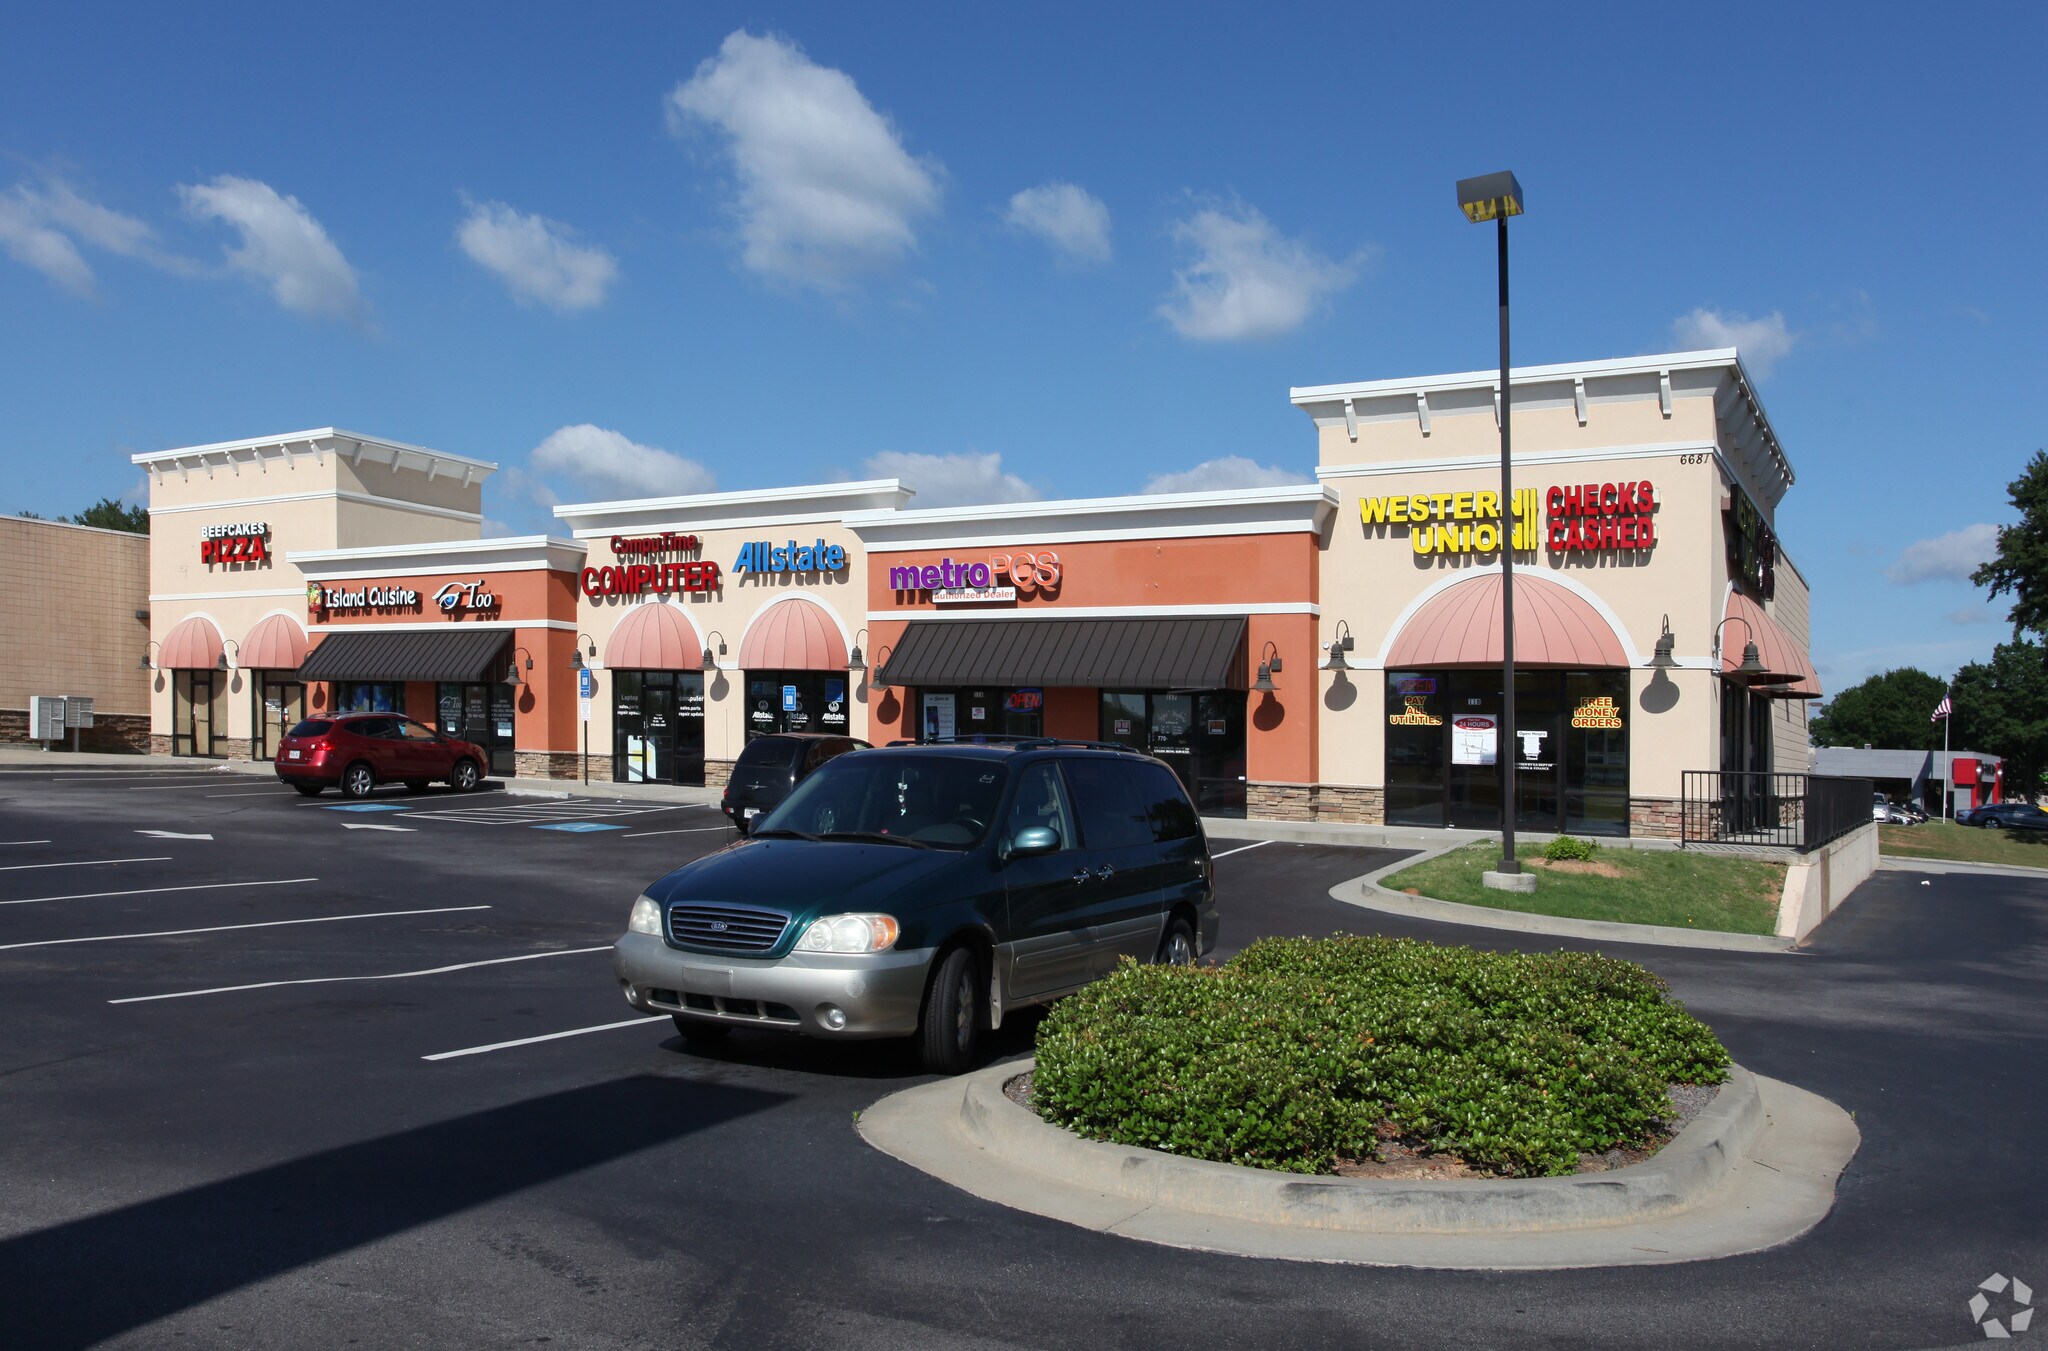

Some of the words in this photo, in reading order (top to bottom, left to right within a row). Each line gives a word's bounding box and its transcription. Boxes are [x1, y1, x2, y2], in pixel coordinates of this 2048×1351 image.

[1680, 454, 1709, 465] 6681
[1546, 480, 1654, 517] CHECKS
[1360, 489, 1523, 524] WESTERN
[201, 522, 265, 538] BEEFCAKES
[1549, 517, 1654, 551] CASHED
[610, 531, 697, 556] CompuTime
[1412, 522, 1523, 554] UNION
[201, 536, 265, 564] PIZZA
[732, 538, 844, 573] Allstate
[889, 551, 1059, 590] metroPCS
[581, 561, 718, 596] COMPUTER
[325, 587, 366, 608] Island
[369, 585, 416, 606] Cuisine
[465, 580, 492, 608] Too
[934, 591, 982, 601] Authorized
[983, 590, 1015, 599] Dealer
[1398, 680, 1434, 692] OPEN
[621, 694, 639, 702] Laptop
[678, 695, 704, 703] computer
[1009, 693, 1040, 708] OPEN
[1405, 696, 1427, 706] PAY
[1581, 697, 1612, 707] FREE
[822, 712, 846, 721] Allstate
[1405, 705, 1427, 716] ALL
[1573, 707, 1619, 717] MONEY
[1390, 714, 1443, 726] UTILITIES
[1571, 718, 1622, 728] ORDERS
